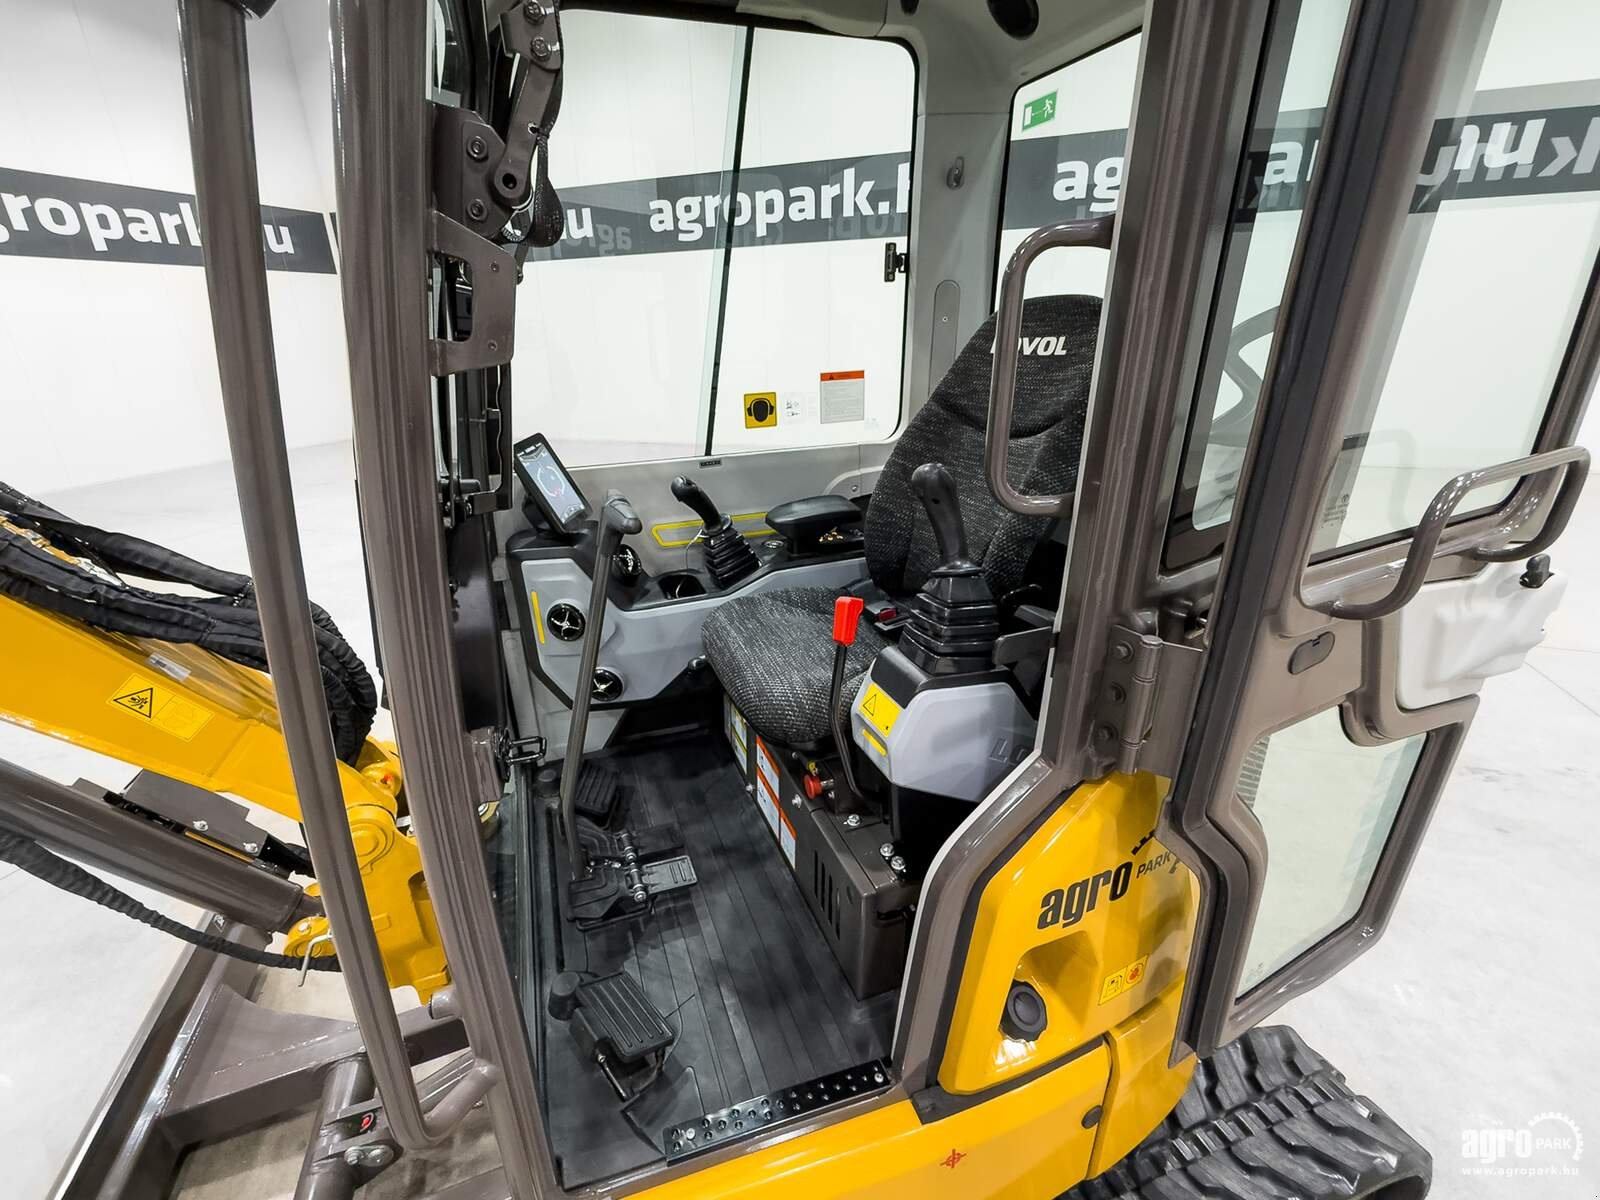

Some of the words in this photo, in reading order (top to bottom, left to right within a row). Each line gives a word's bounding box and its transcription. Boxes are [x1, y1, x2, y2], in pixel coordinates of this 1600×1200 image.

[990, 336, 1067, 355] VOL
[1037, 861, 1133, 930] agro
[1136, 850, 1170, 878] PARK
